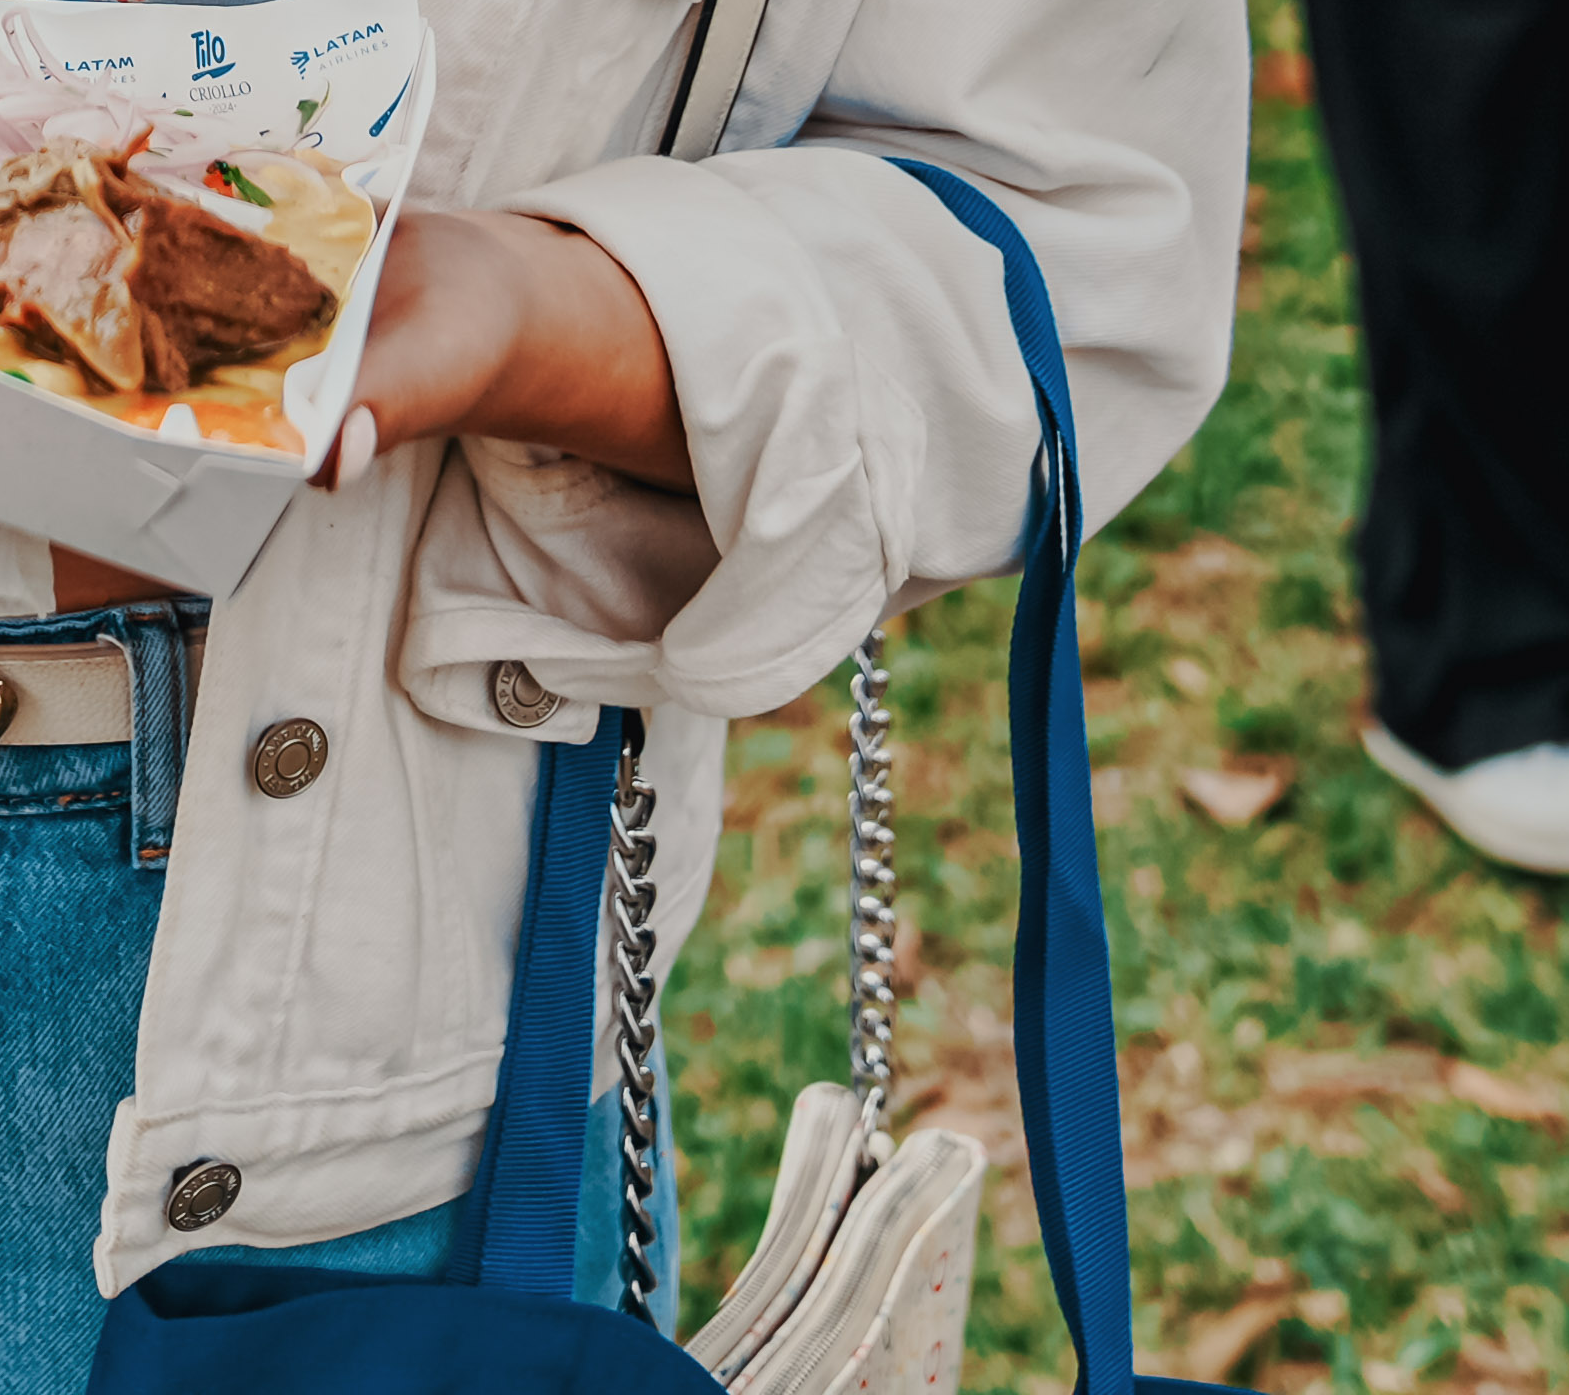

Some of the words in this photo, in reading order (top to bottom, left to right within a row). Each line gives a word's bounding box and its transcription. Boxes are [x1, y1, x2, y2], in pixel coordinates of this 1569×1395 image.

[313, 22, 385, 58] LATAM
[64, 56, 135, 73] LATAM
[318, 38, 389, 72] AIRLINES
[189, 80, 252, 102] CRIOLLO
